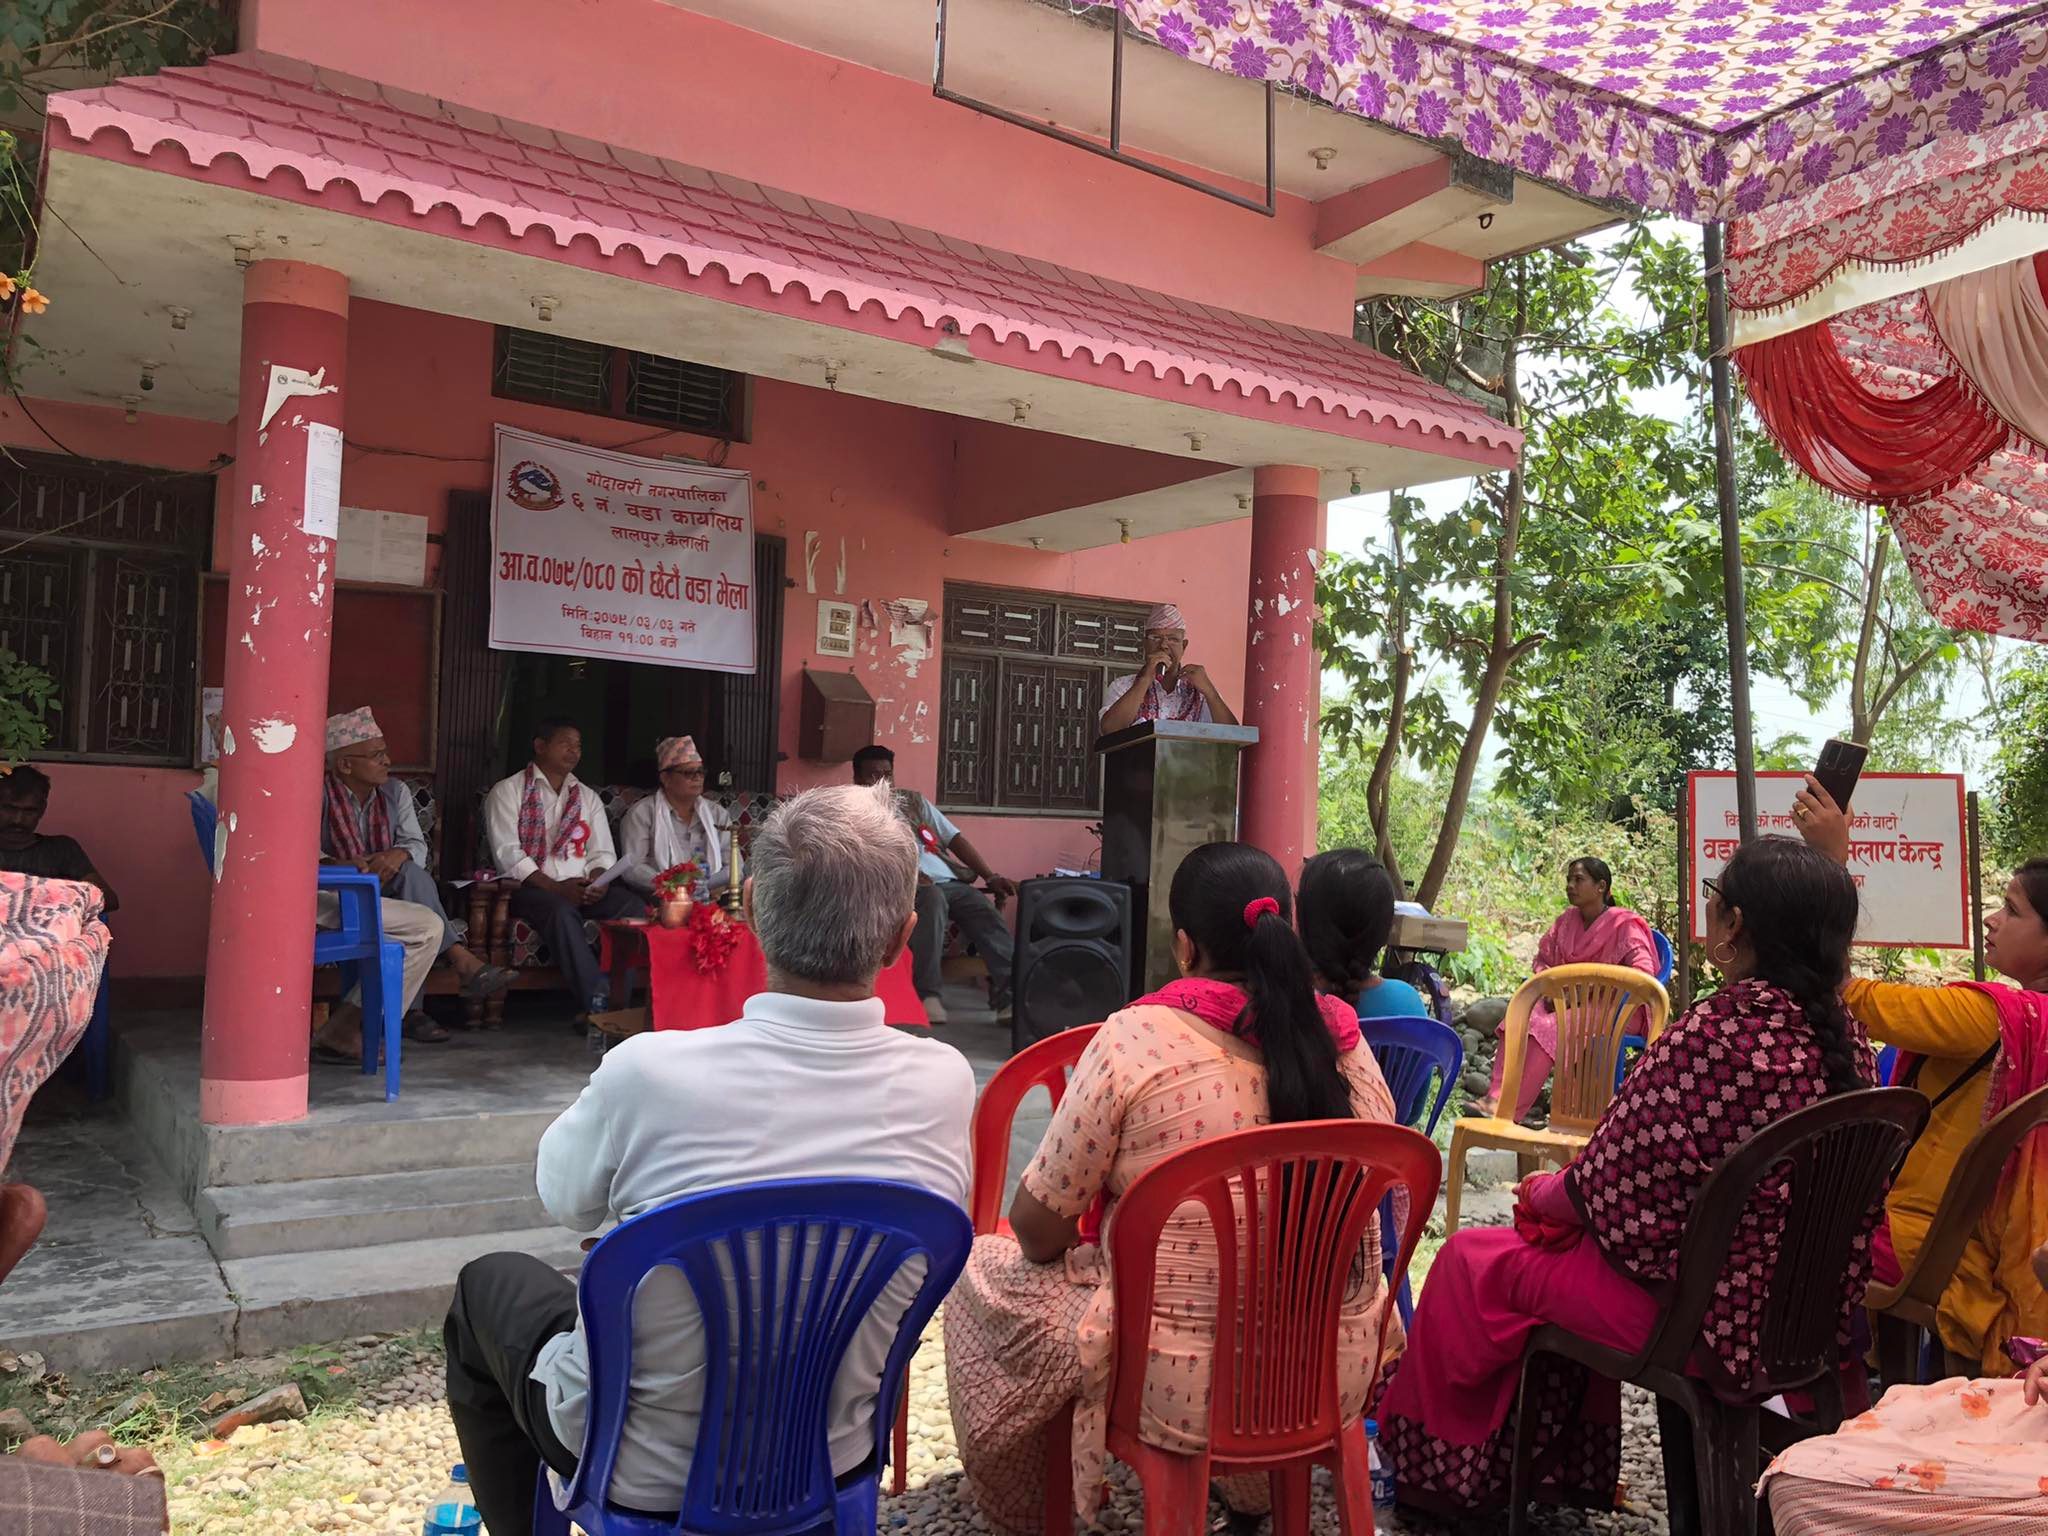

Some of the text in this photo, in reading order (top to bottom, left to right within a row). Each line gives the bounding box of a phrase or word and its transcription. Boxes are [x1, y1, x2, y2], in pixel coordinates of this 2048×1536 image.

[586, 470, 727, 503] गोदावरी नगरपालिका
[571, 491, 585, 512] ६
[625, 503, 662, 522] वडा
[671, 508, 744, 533] कार्यालय
[622, 558, 645, 595] को
[685, 576, 712, 605] वडा
[717, 572, 749, 610] भेला
[580, 623, 613, 640] बिहान
[660, 635, 678, 648] बजे
[680, 619, 696, 632] गते
[1898, 834, 1944, 872] केन्द्र
